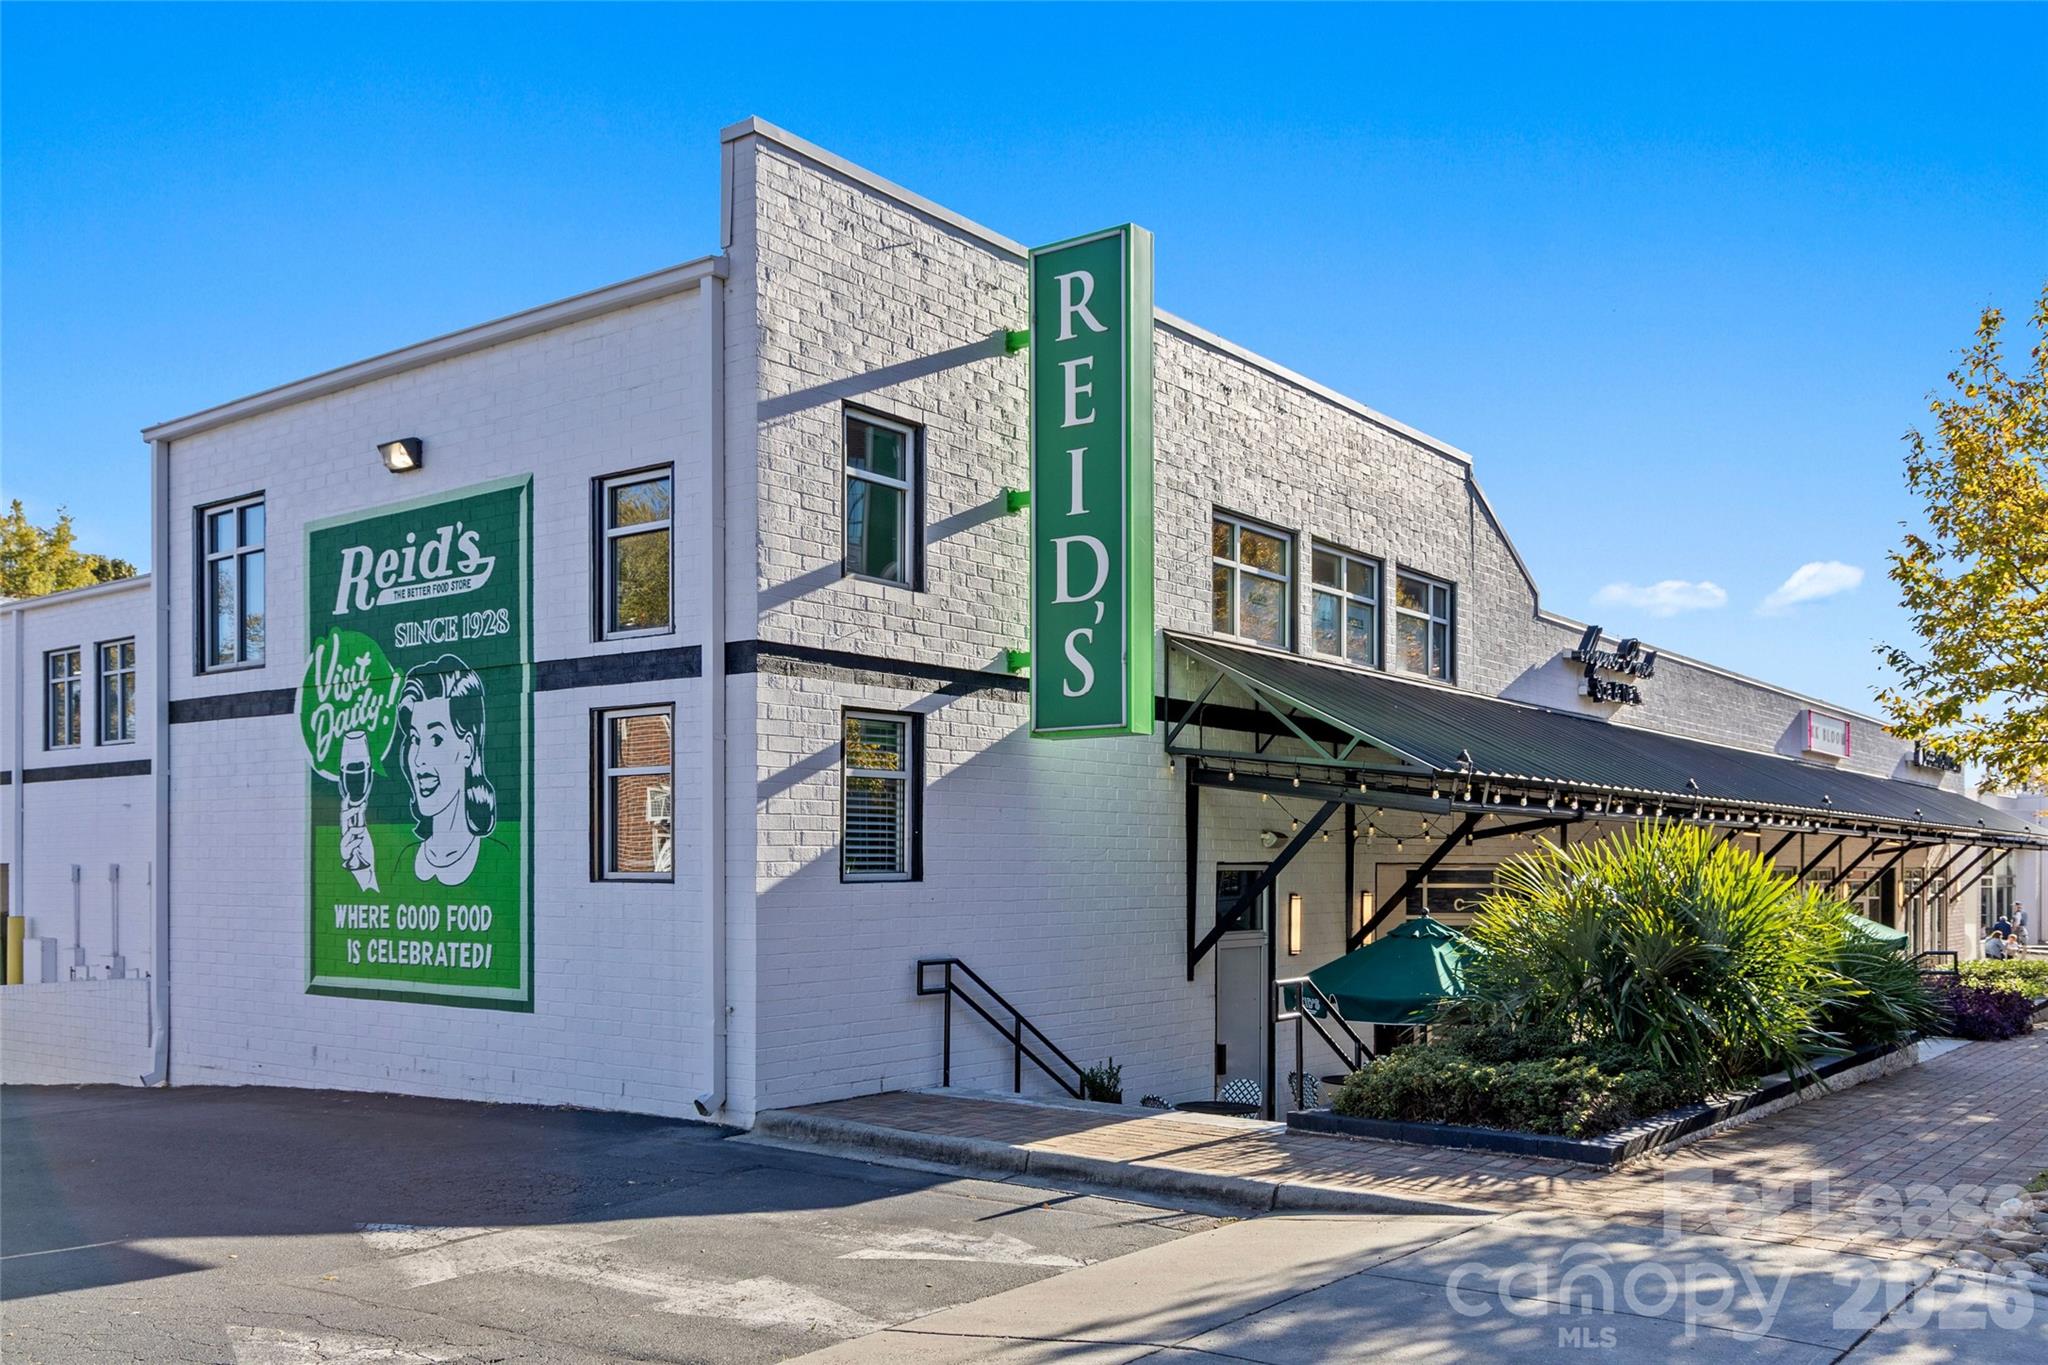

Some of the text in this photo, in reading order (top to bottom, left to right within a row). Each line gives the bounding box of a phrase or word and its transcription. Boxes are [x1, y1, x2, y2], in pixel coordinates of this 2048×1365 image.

[1049, 269, 1110, 698] REID'S
[332, 520, 493, 616] Reid's
[393, 578, 472, 600] THE BETTER FOOD STORE
[394, 607, 511, 648] SINCE 1928
[315, 633, 372, 702] Visit
[310, 672, 401, 762] Daily!
[334, 904, 493, 932] WHERE GOOD FOOD
[346, 938, 493, 969] IS CELEBRATED!
